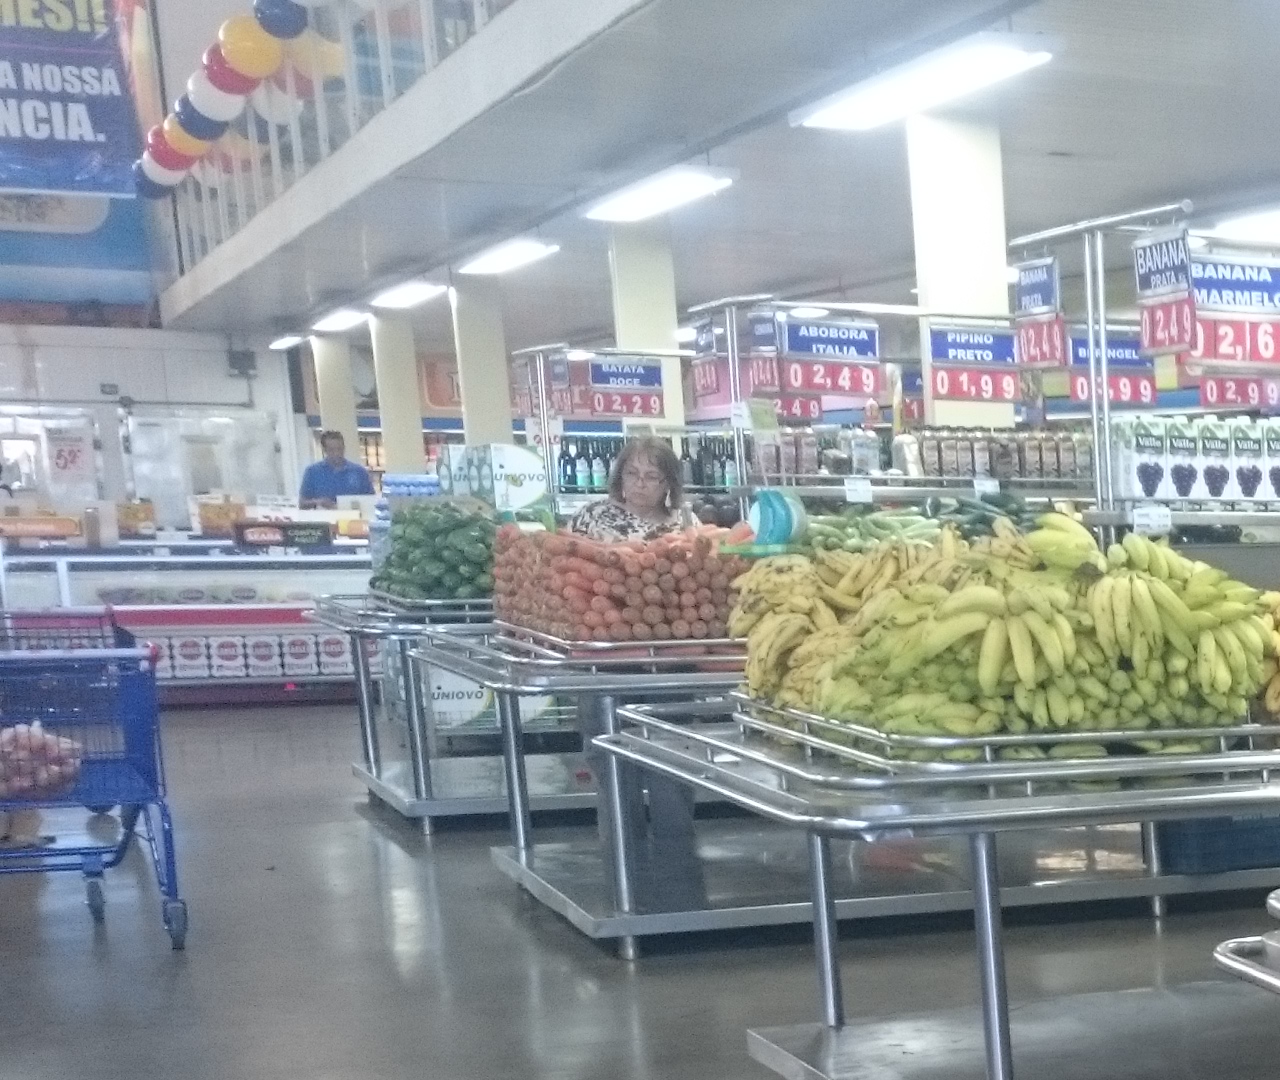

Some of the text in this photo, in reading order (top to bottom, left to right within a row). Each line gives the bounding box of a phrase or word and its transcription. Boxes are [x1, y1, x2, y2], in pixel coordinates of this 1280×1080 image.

[22, 62, 122, 96] NOSSA
[1136, 239, 1188, 275] BANANA
[1191, 261, 1273, 283] BANANA
[1143, 304, 1192, 348] 02,49
[936, 371, 1015, 399] 01,99
